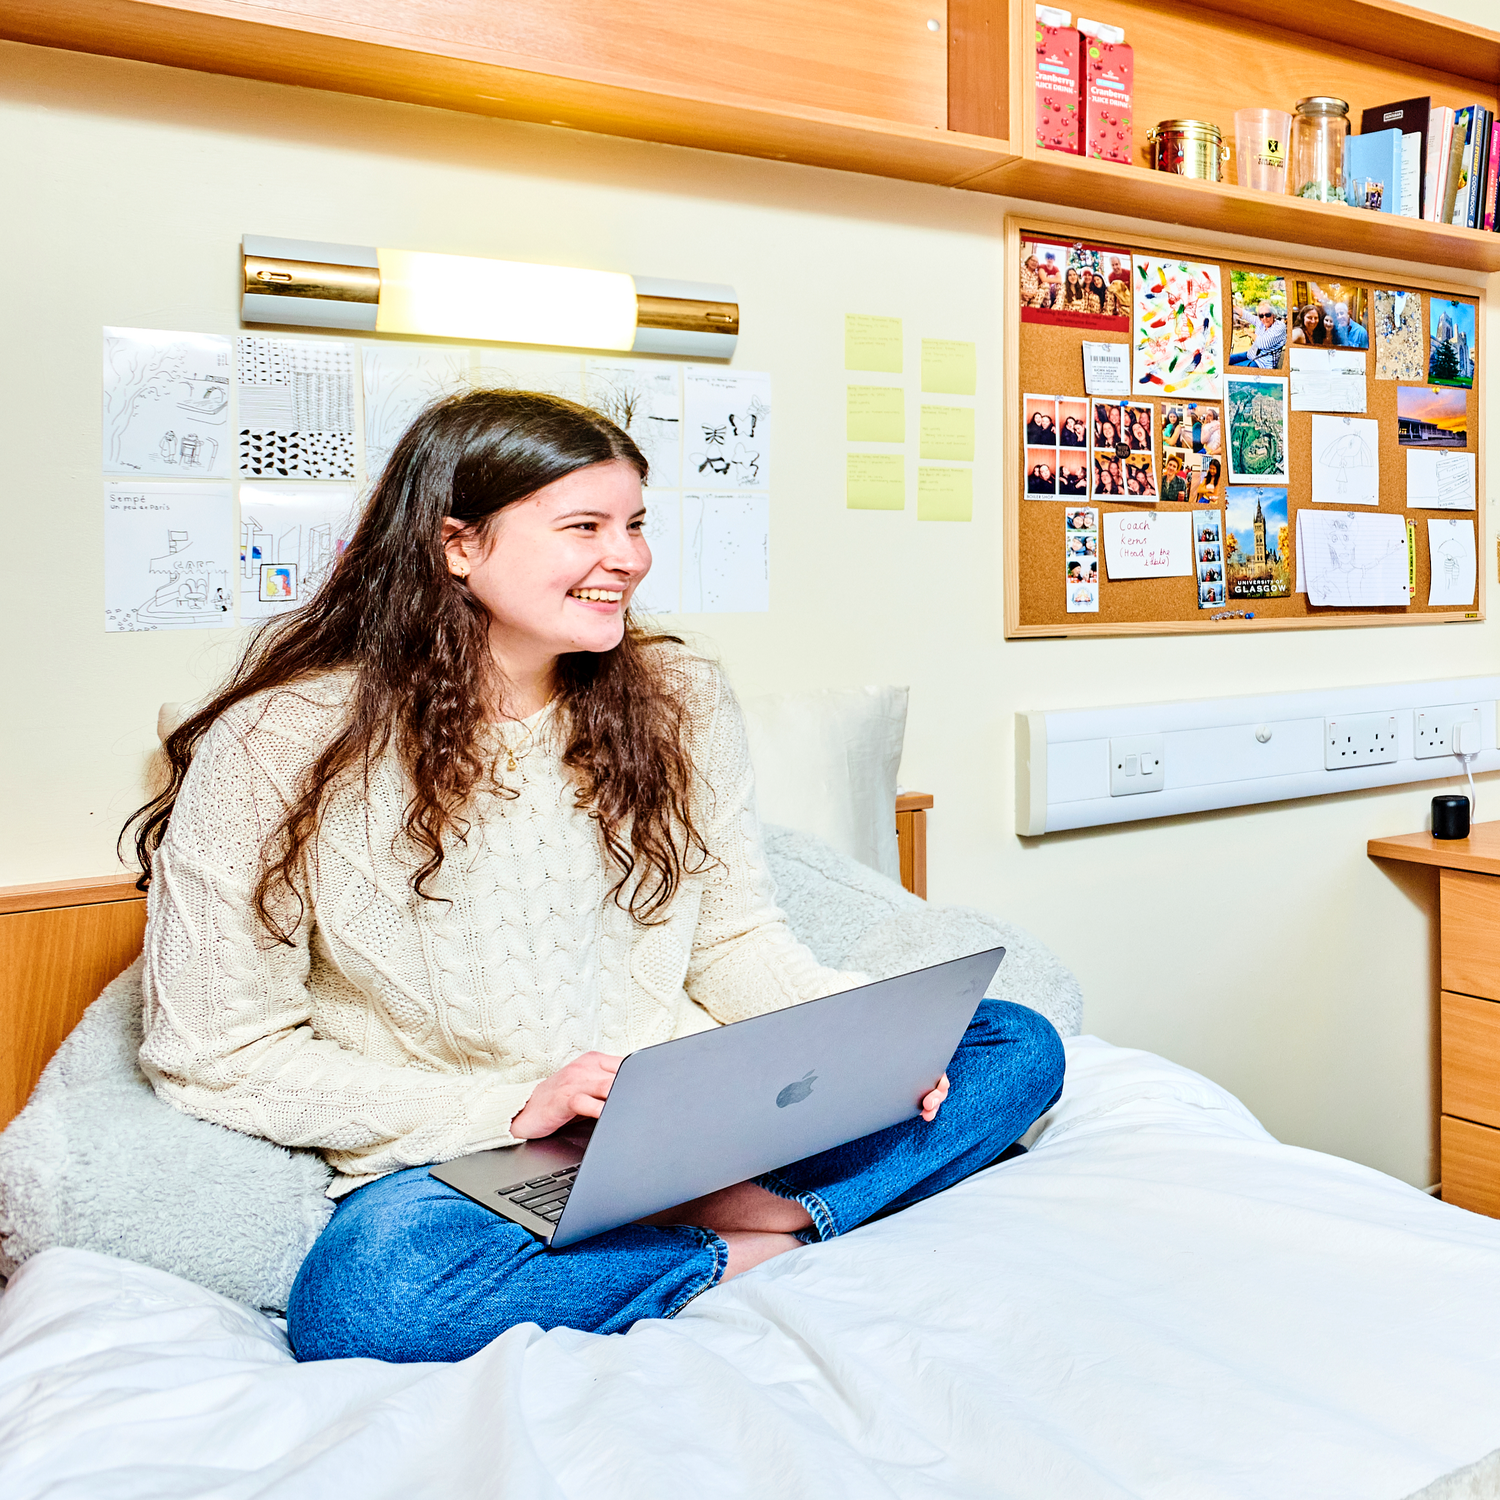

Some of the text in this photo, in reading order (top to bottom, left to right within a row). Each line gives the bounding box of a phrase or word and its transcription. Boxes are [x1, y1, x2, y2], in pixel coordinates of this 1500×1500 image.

[1053, 84, 1074, 94] DRINK
[1090, 86, 1130, 102] Cranberry
[1092, 95, 1129, 108] JUICE DRINK
[1475, 118, 1483, 146] HUNGRY
[1472, 145, 1480, 176] STUDENT
[1469, 176, 1477, 217] COOKBOOK
[110, 494, 146, 505] Sempé
[1119, 518, 1151, 531] Coach
[1234, 584, 1287, 594] GLASGOW
